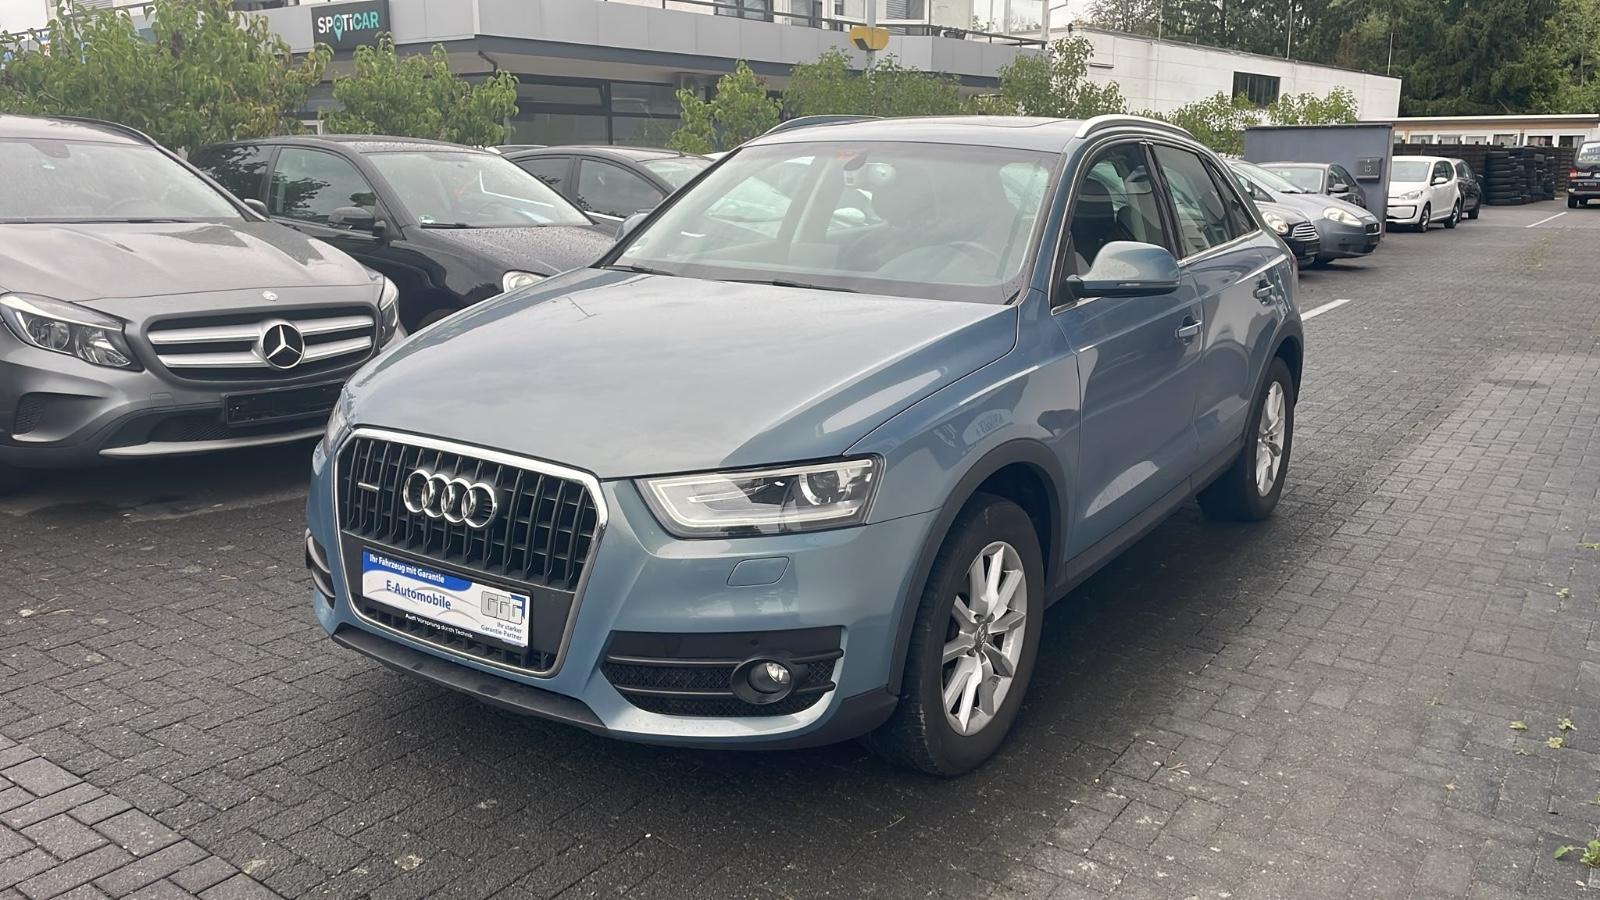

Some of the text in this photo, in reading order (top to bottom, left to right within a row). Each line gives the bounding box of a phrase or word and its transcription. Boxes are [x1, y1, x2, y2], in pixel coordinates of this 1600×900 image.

[369, 553, 445, 584] Ihr Fahrzeug mit Garantie
[386, 579, 451, 610] E-Automobile
